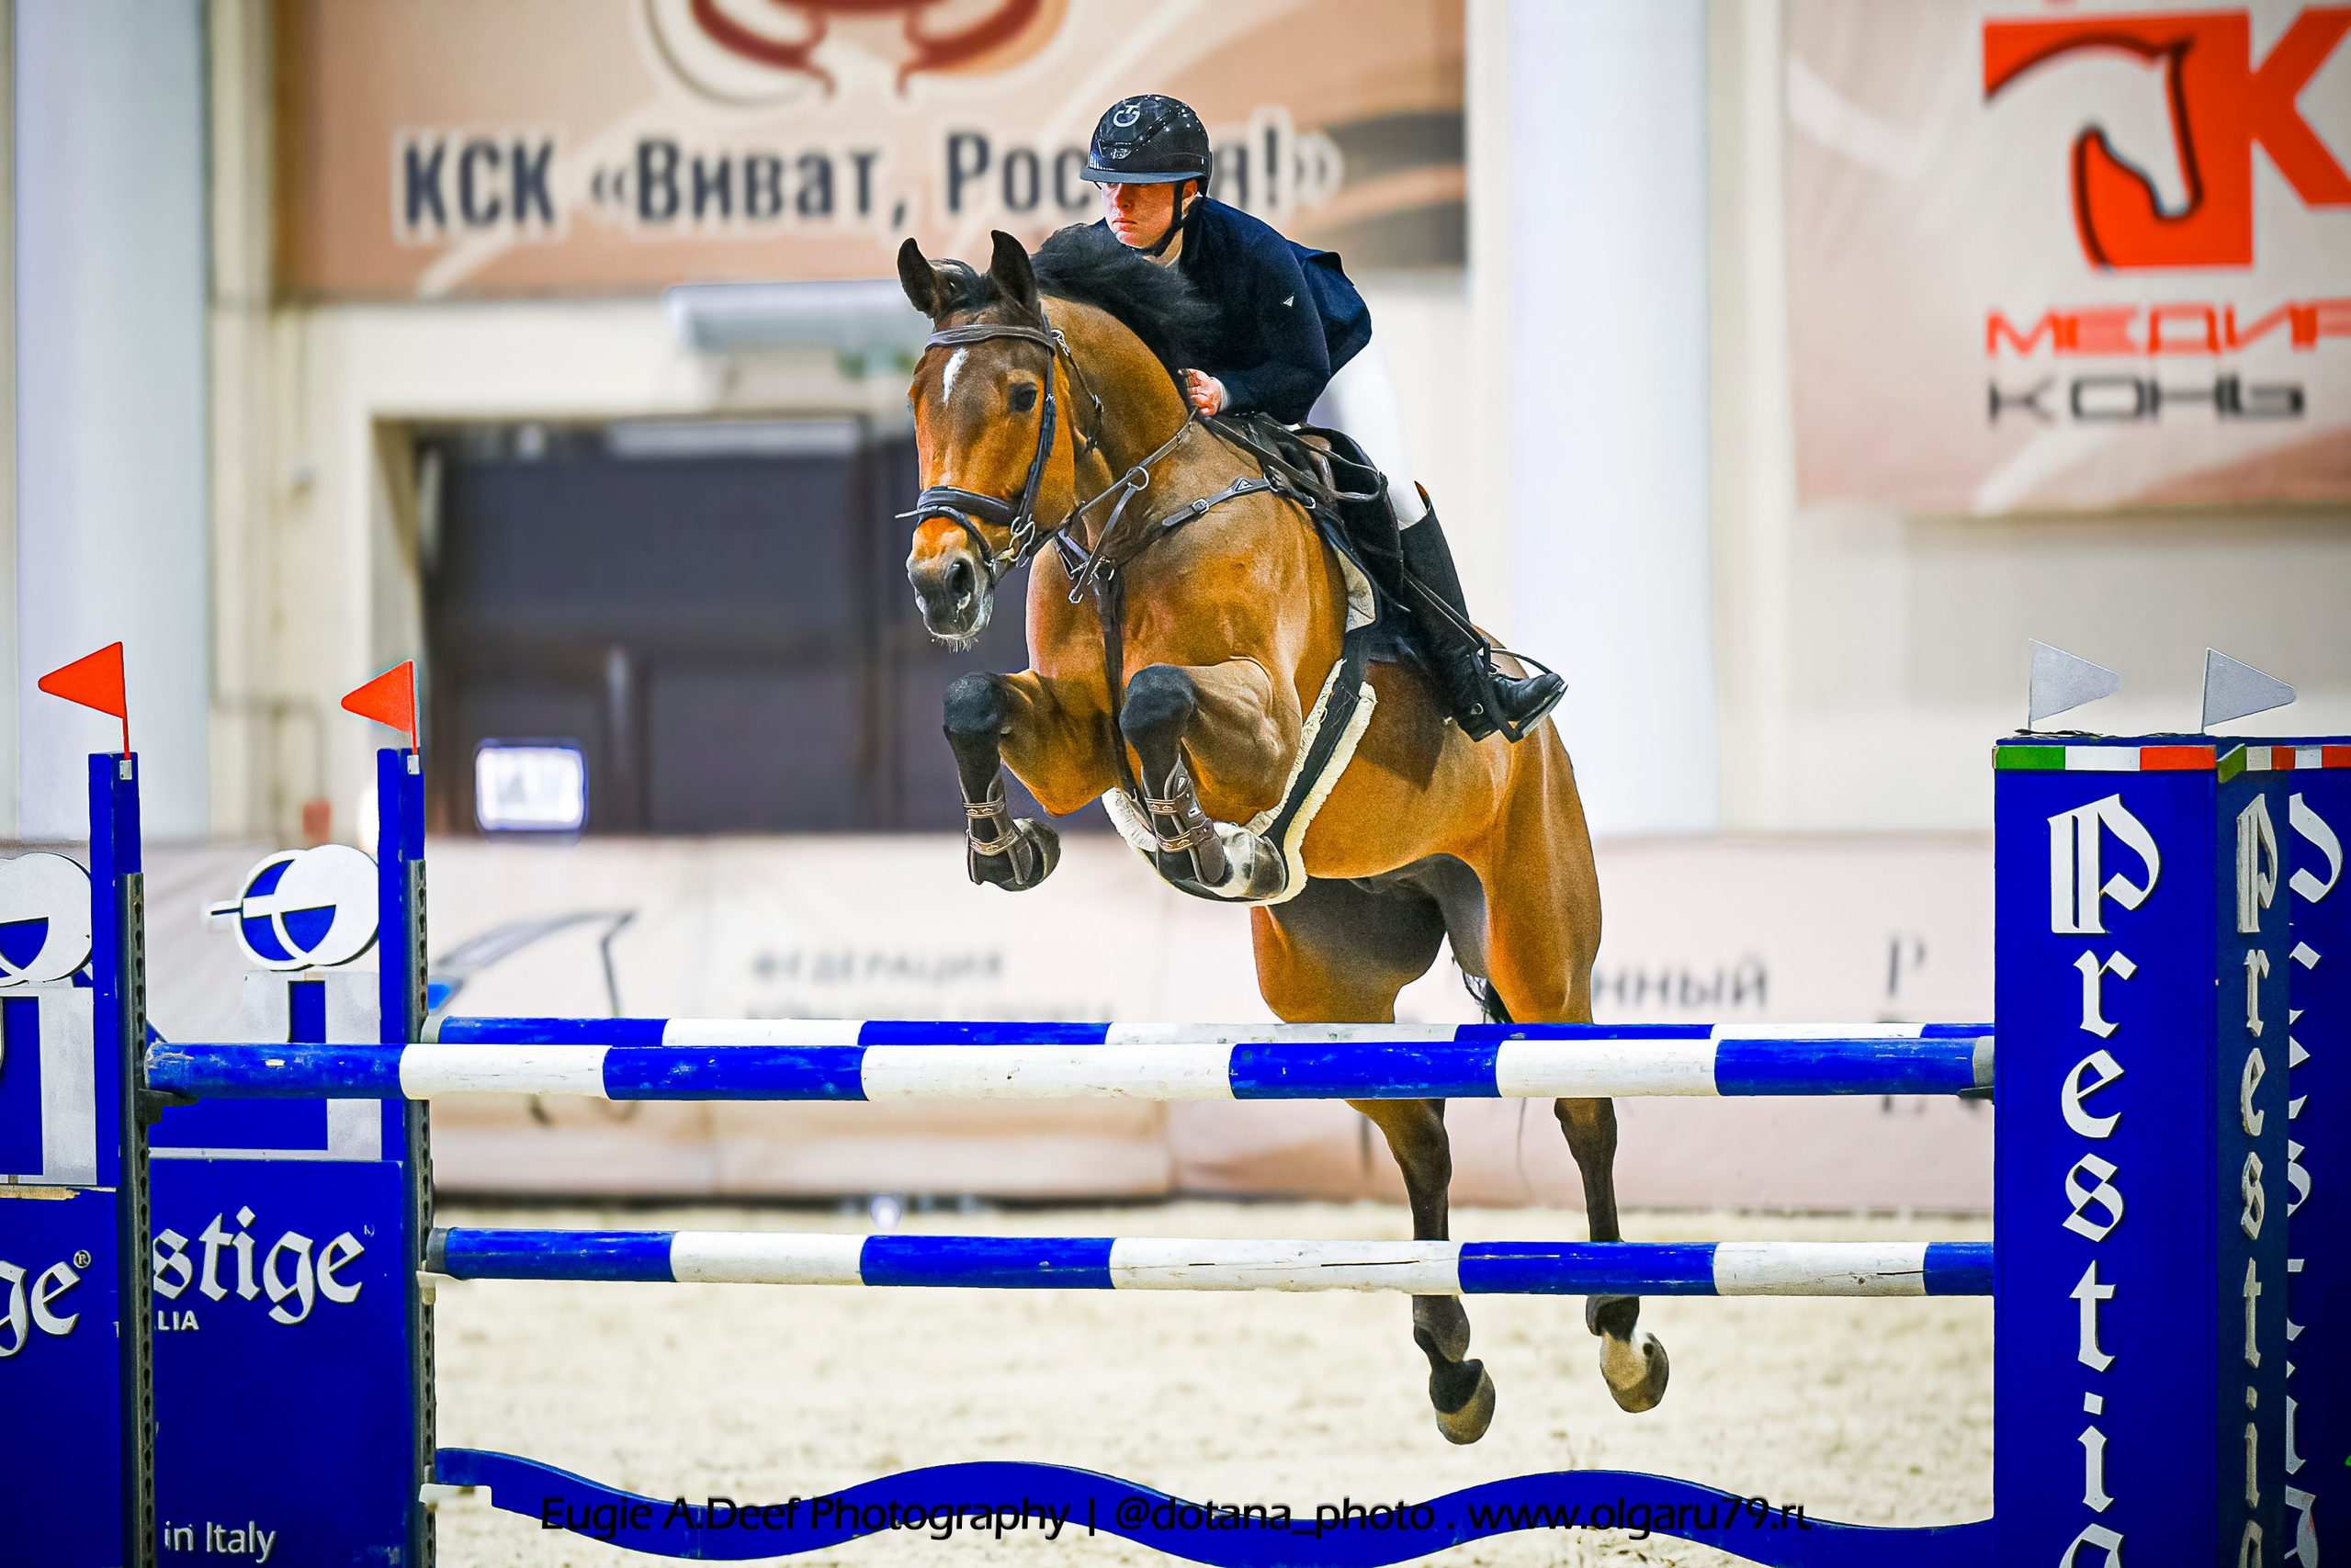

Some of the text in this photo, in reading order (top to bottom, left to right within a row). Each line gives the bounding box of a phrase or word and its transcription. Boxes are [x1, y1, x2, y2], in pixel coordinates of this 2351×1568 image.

[404, 125, 1328, 228] КСК «Виват, Рося!»
[1988, 373, 2304, 424] КОНЬ
[153, 1205, 365, 1325] stige
[164, 1520, 277, 1563] in Italy
